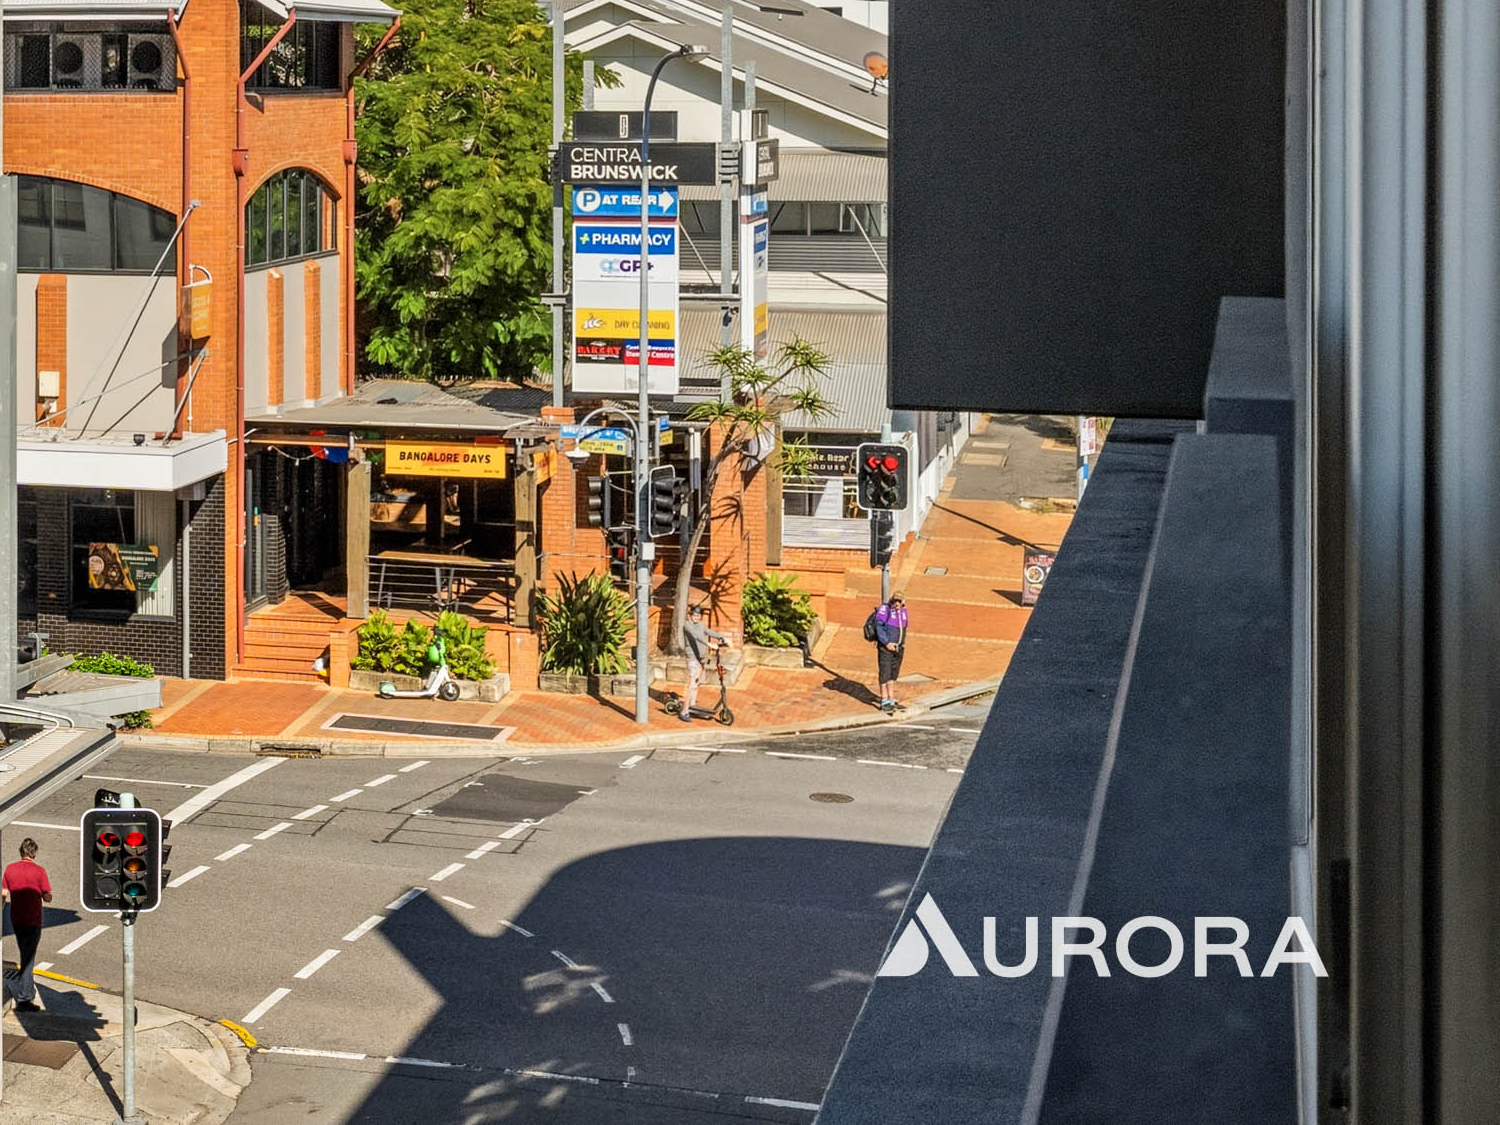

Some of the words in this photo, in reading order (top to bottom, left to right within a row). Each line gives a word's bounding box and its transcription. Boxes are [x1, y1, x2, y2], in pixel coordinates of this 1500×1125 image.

[570, 148, 652, 163] CENTRA
[570, 165, 678, 180] BRUNSWICK
[583, 192, 596, 207] P
[602, 194, 618, 205] AT
[399, 451, 459, 463] BANGALORE
[463, 453, 491, 464] DAYS
